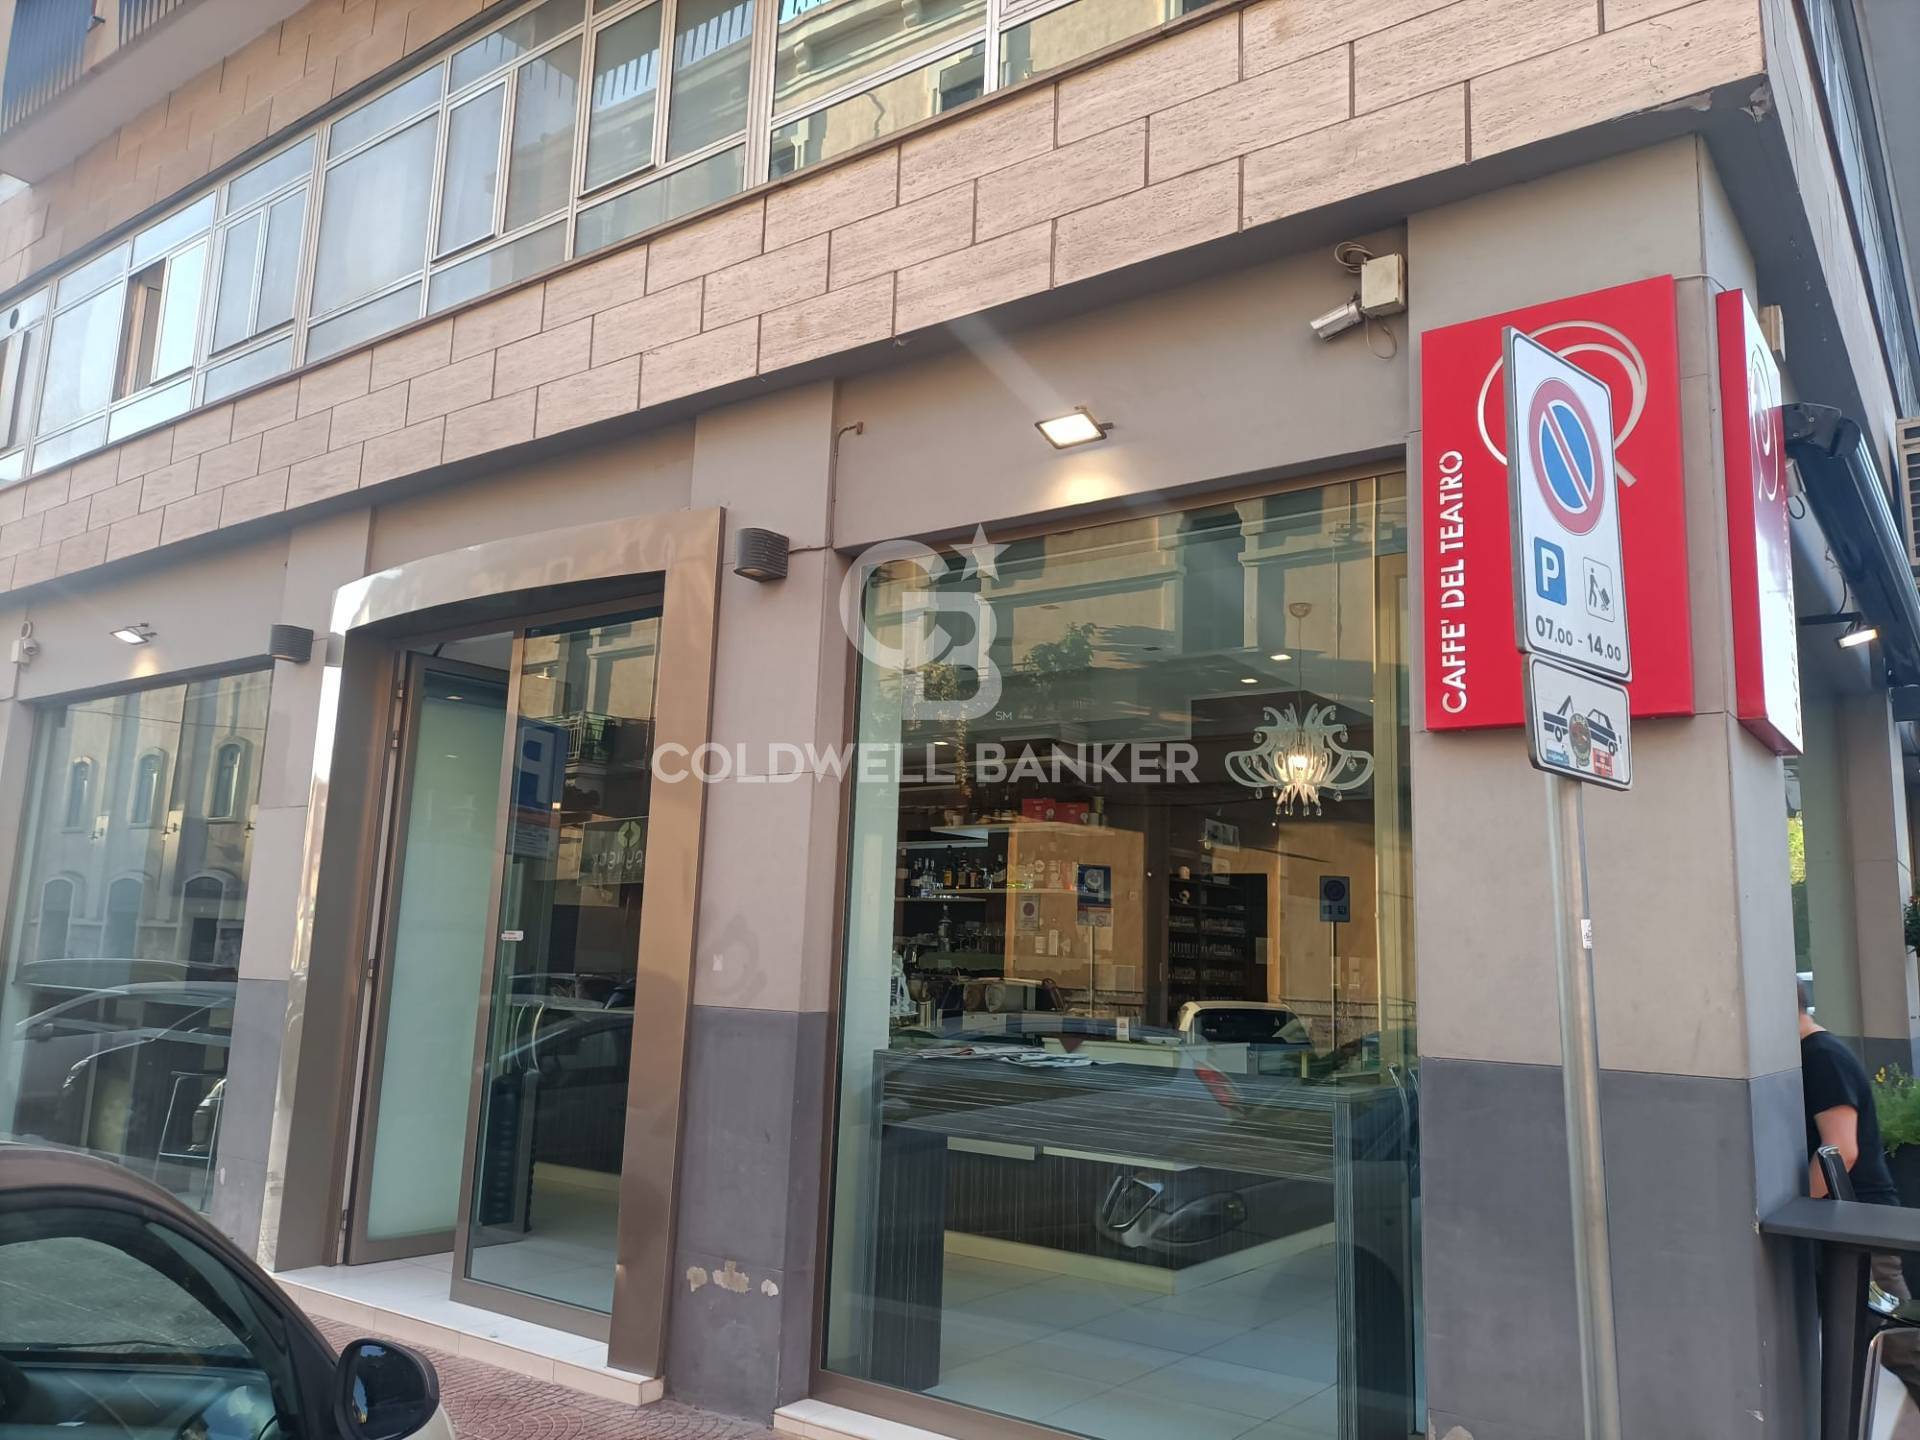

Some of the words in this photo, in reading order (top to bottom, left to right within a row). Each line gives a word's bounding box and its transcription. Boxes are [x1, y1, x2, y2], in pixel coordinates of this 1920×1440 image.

[1439, 450, 1464, 554] TEATRO
[1440, 558, 1466, 609] DEL
[1541, 546, 1560, 592] P
[1535, 614, 1573, 647] 07.00
[1587, 632, 1621, 661] 14.00
[1441, 619, 1467, 713] CAFFE'
